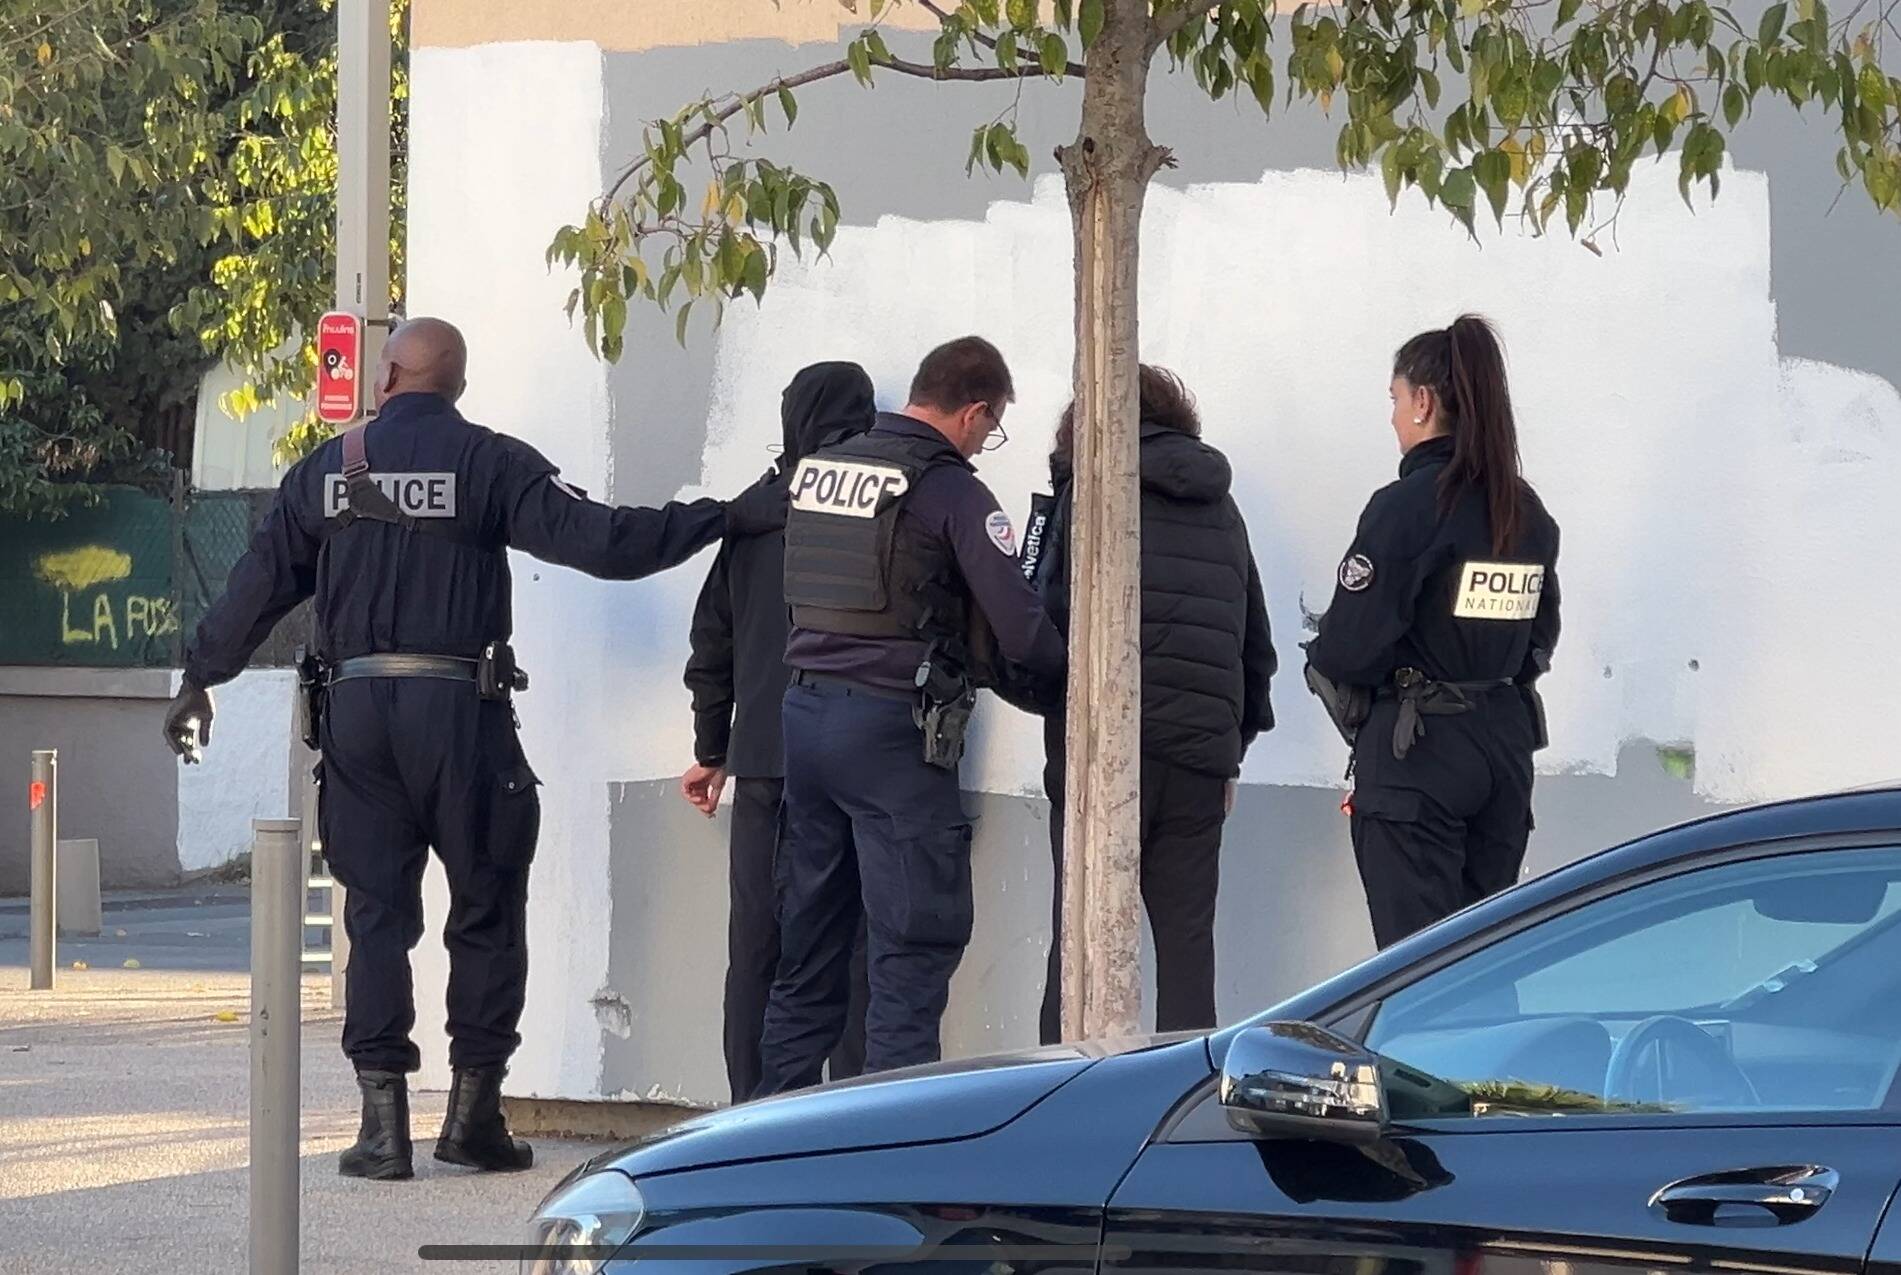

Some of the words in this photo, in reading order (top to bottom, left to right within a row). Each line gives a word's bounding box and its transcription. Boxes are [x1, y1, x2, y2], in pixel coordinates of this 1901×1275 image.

[332, 479, 446, 510] PICE
[1021, 515, 1046, 580] elvetica
[62, 591, 118, 649] LA
